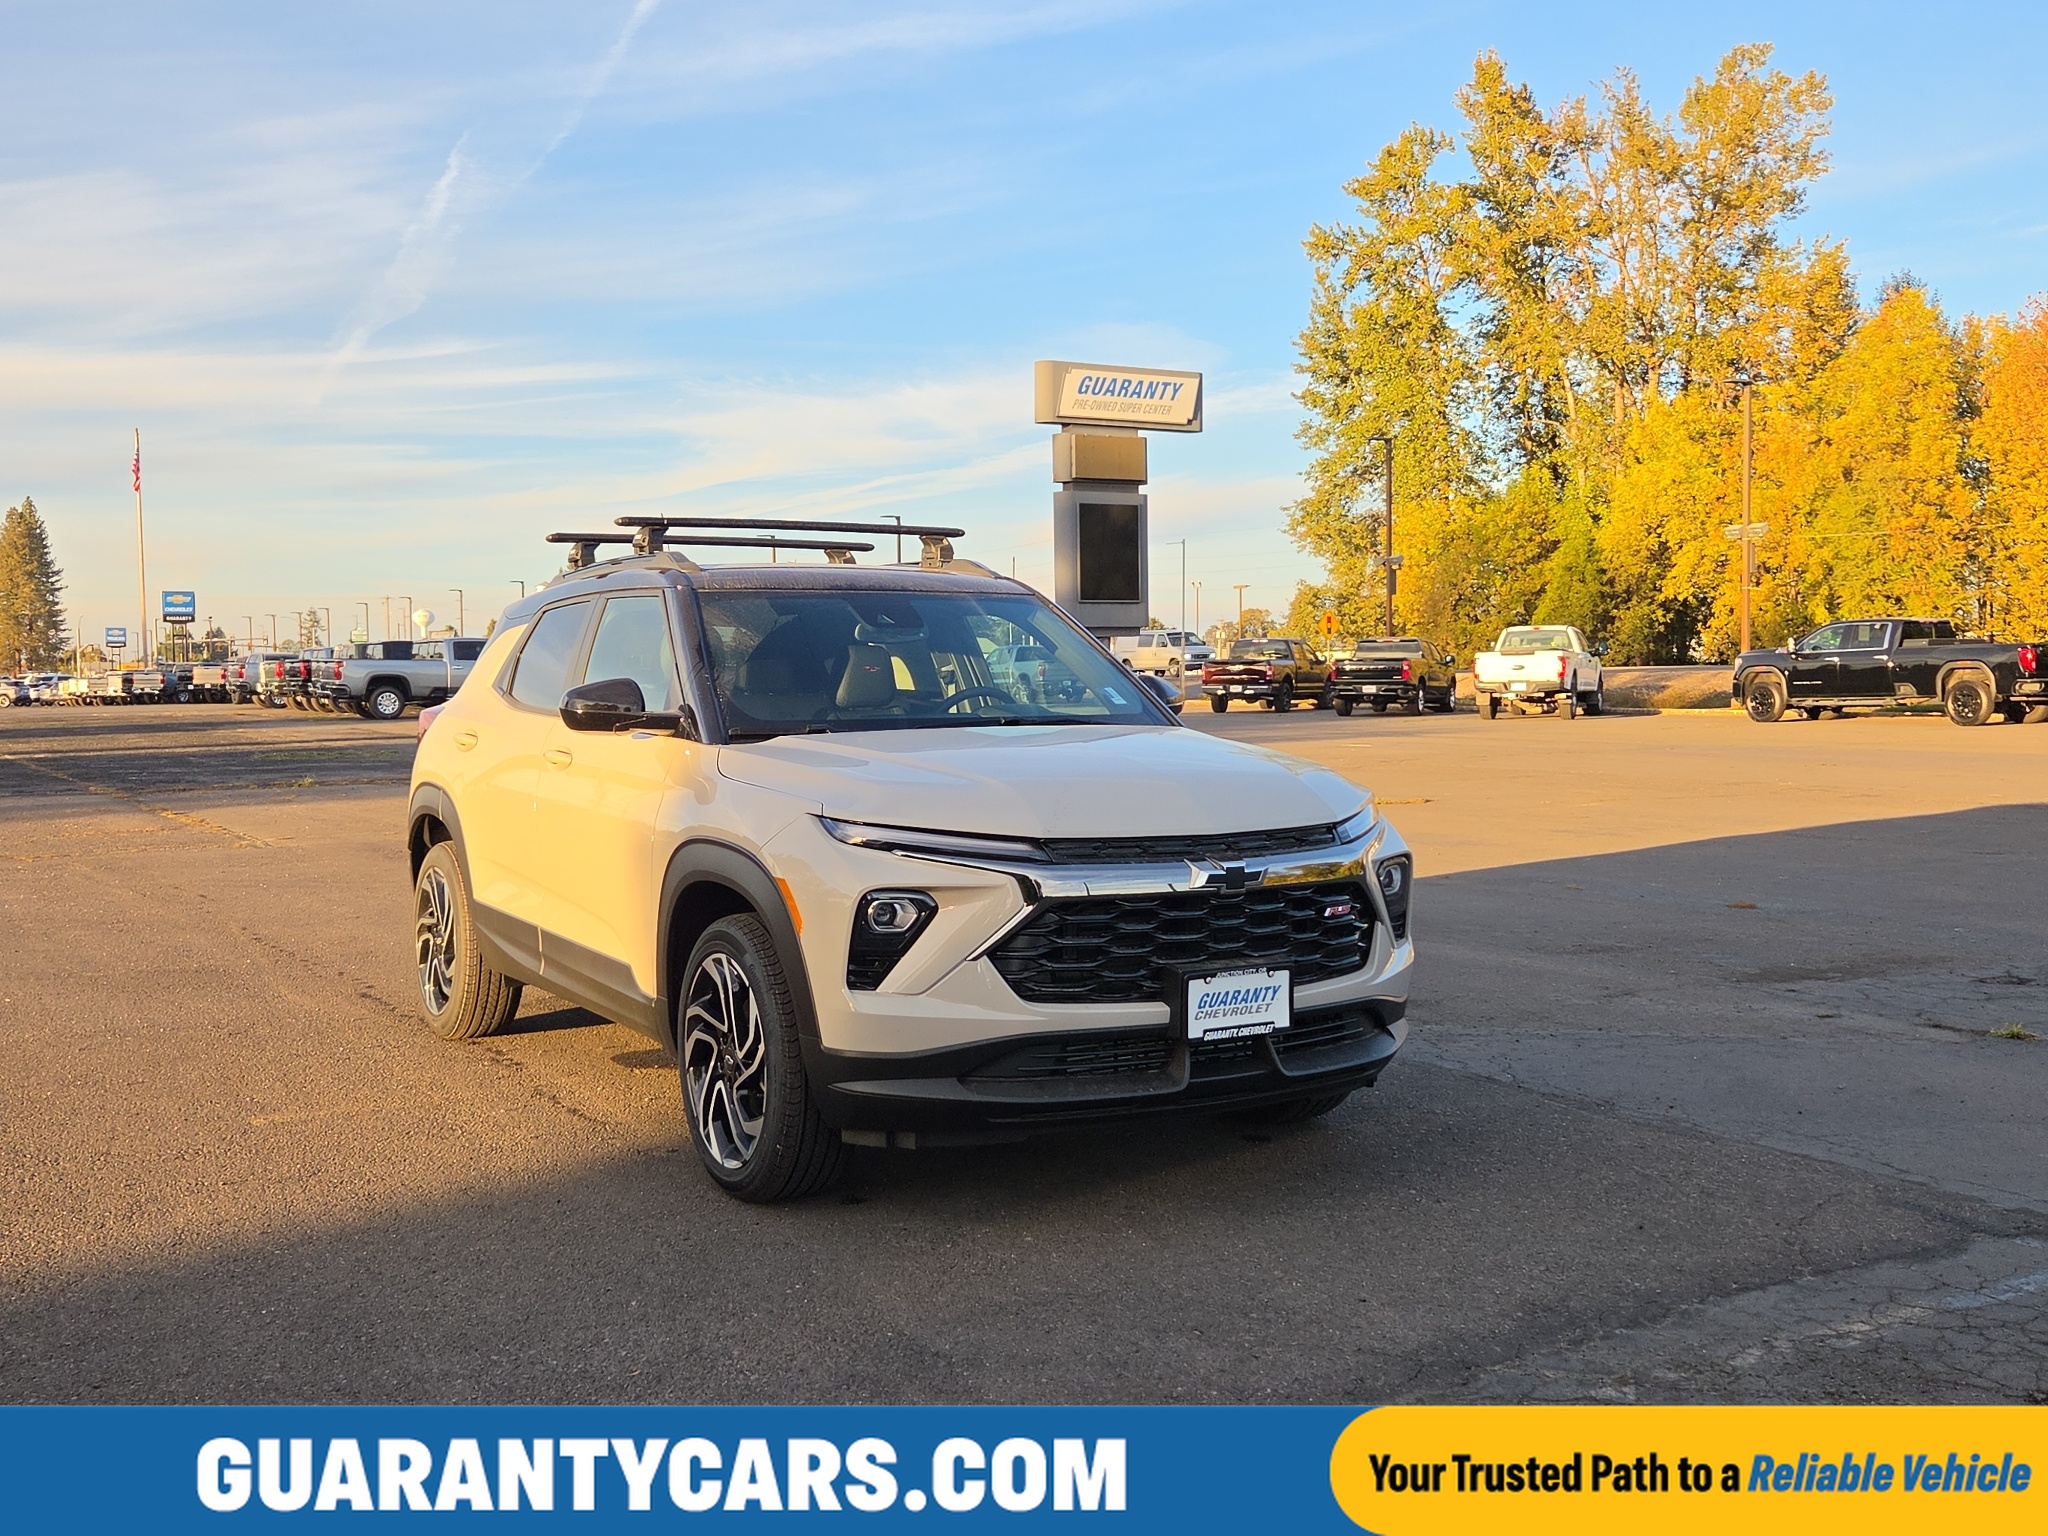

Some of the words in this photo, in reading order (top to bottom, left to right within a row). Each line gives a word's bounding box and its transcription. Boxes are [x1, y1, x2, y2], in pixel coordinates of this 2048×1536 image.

[1077, 375, 1184, 400] GUARANTY
[1072, 399, 1117, 412] PRE-OWNED
[1117, 402, 1142, 413] SUPER
[1143, 404, 1172, 416] CENTER
[1324, 905, 1351, 917] RS
[1198, 985, 1281, 1010] GUARANTY
[1195, 1003, 1272, 1021] CHEVROLET
[1238, 1024, 1275, 1036] CHEVROLET
